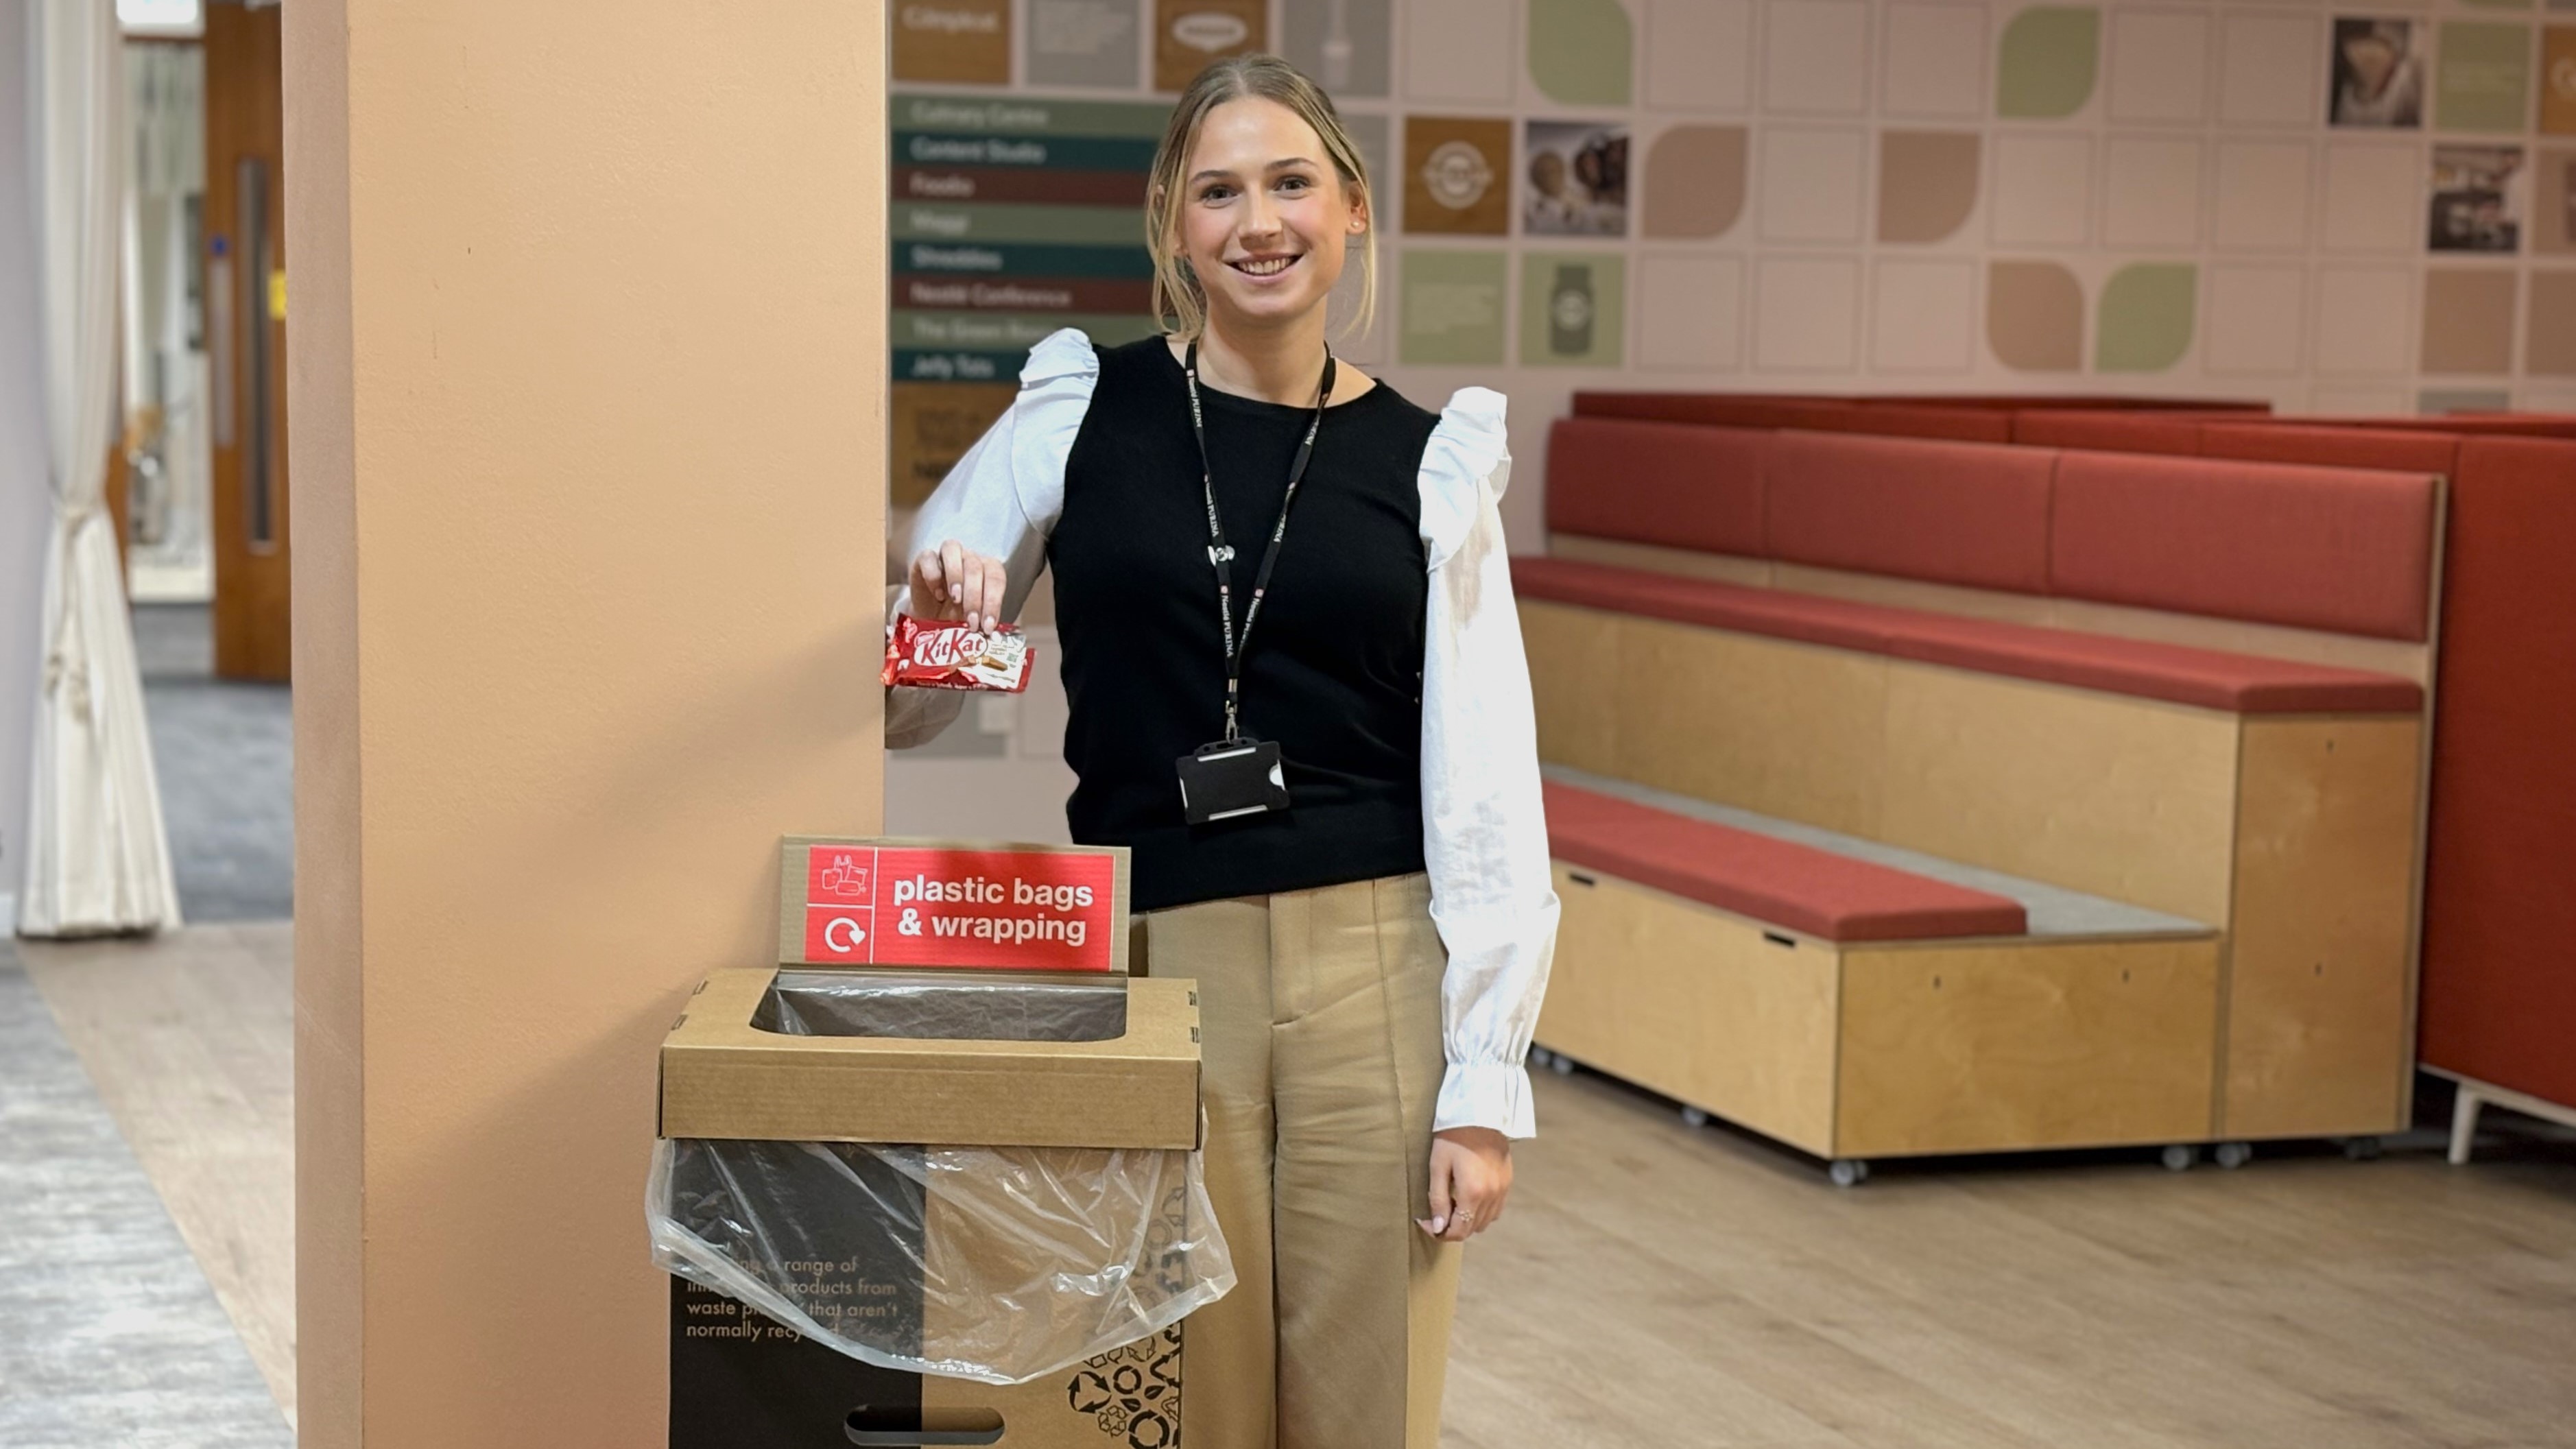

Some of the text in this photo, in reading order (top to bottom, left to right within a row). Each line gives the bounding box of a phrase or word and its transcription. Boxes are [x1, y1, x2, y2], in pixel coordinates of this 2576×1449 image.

[910, 136, 1047, 163] Content Studio
[911, 245, 1002, 270] Shreddies
[973, 283, 1071, 306] Conference
[914, 317, 946, 339] The
[912, 355, 954, 381] Jelly
[920, 628, 984, 665] KitKat
[894, 874, 1093, 911] plastic bags
[897, 907, 1086, 946] & wrapping
[784, 1260, 834, 1276] range
[840, 1256, 858, 1272] of
[858, 1277, 896, 1295] from
[687, 1302, 736, 1315] waste
[809, 1300, 842, 1317] that
[687, 1320, 762, 1342] normally
